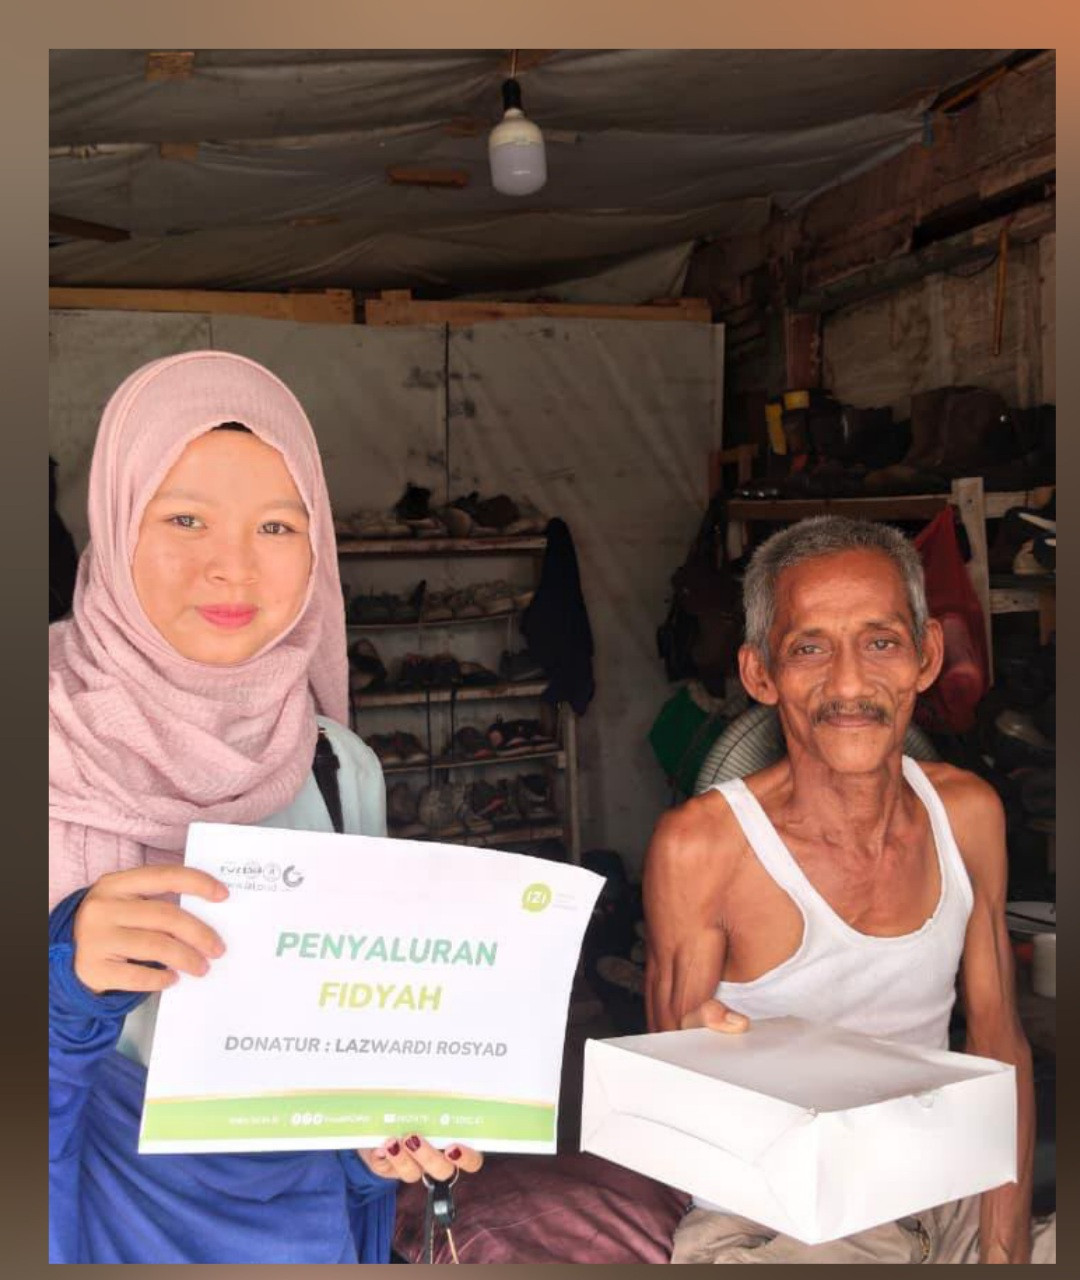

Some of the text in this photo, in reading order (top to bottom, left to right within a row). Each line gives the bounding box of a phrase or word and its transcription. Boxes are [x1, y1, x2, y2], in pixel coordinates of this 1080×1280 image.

[275, 931, 498, 966] PENYALURAN
[318, 981, 443, 1011] FIDYAH
[224, 1036, 321, 1053] DONATUR
[335, 1038, 432, 1055] LAZWARDI
[436, 1041, 508, 1058] ROSYAD
